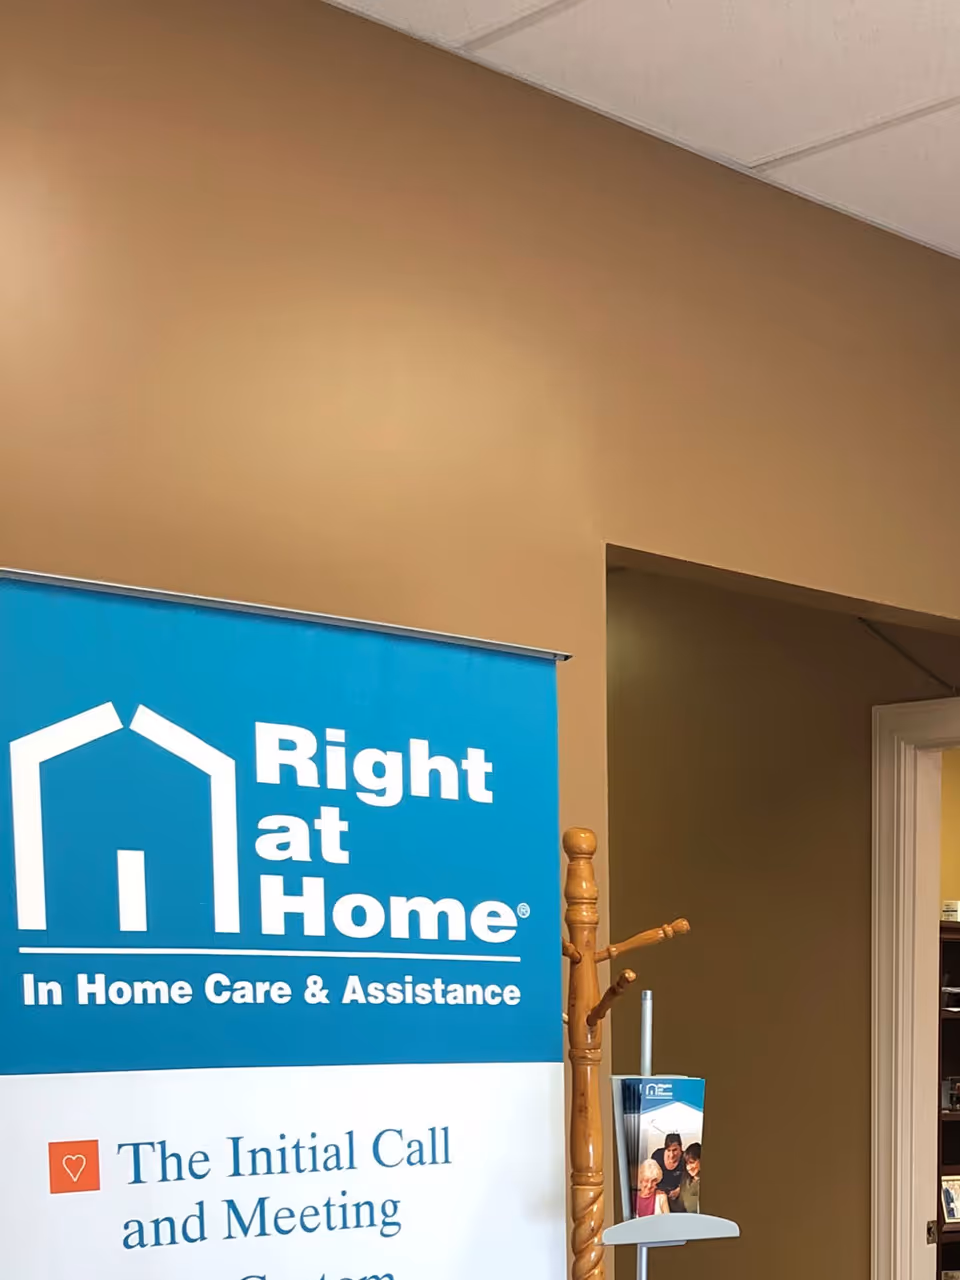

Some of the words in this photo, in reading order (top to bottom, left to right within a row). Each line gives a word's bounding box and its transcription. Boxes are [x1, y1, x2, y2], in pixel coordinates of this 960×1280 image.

[256, 722, 493, 808] Right
[255, 806, 349, 864] at
[23, 973, 62, 1005] In
[77, 974, 193, 1005] Home
[204, 973, 292, 1004] Care
[304, 975, 330, 1004] &
[341, 975, 521, 1005] Assistance
[117, 1140, 211, 1185] The
[228, 1130, 356, 1177] Initial
[372, 1126, 452, 1168] Call
[122, 1200, 207, 1250] and
[222, 1190, 402, 1240] Meeting
